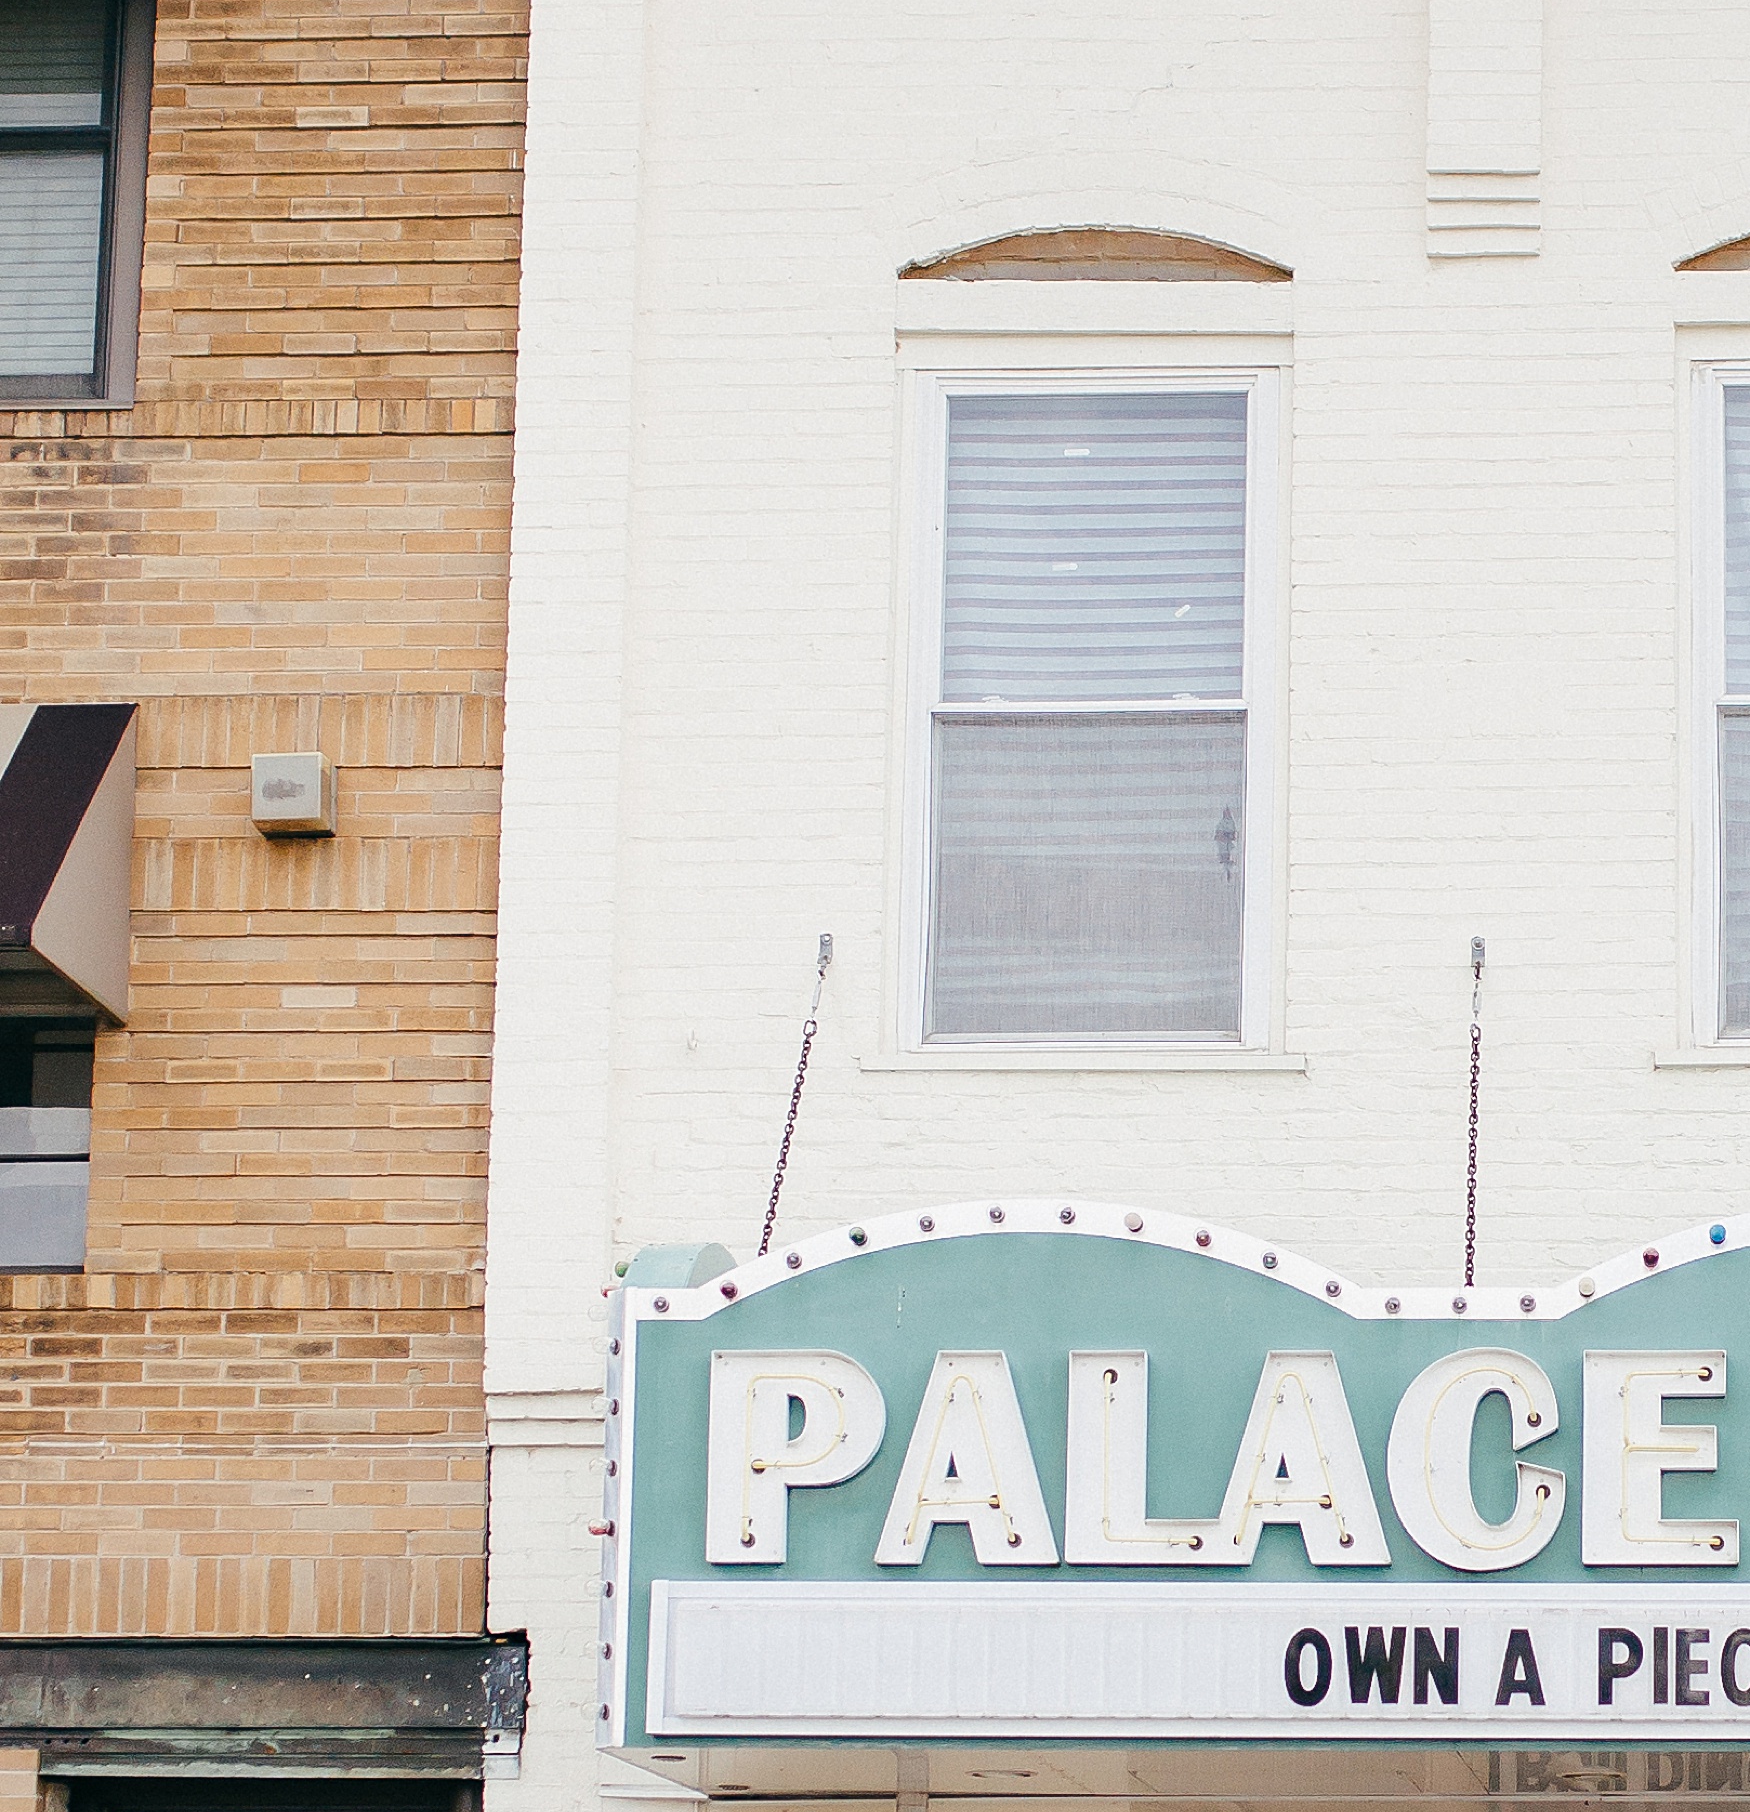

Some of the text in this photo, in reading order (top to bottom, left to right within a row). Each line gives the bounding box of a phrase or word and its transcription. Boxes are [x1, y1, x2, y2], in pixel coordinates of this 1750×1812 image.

[706, 1348, 1739, 1572] PALACE
[1284, 1626, 1460, 1707] OWN
[1495, 1628, 1546, 1706] A
